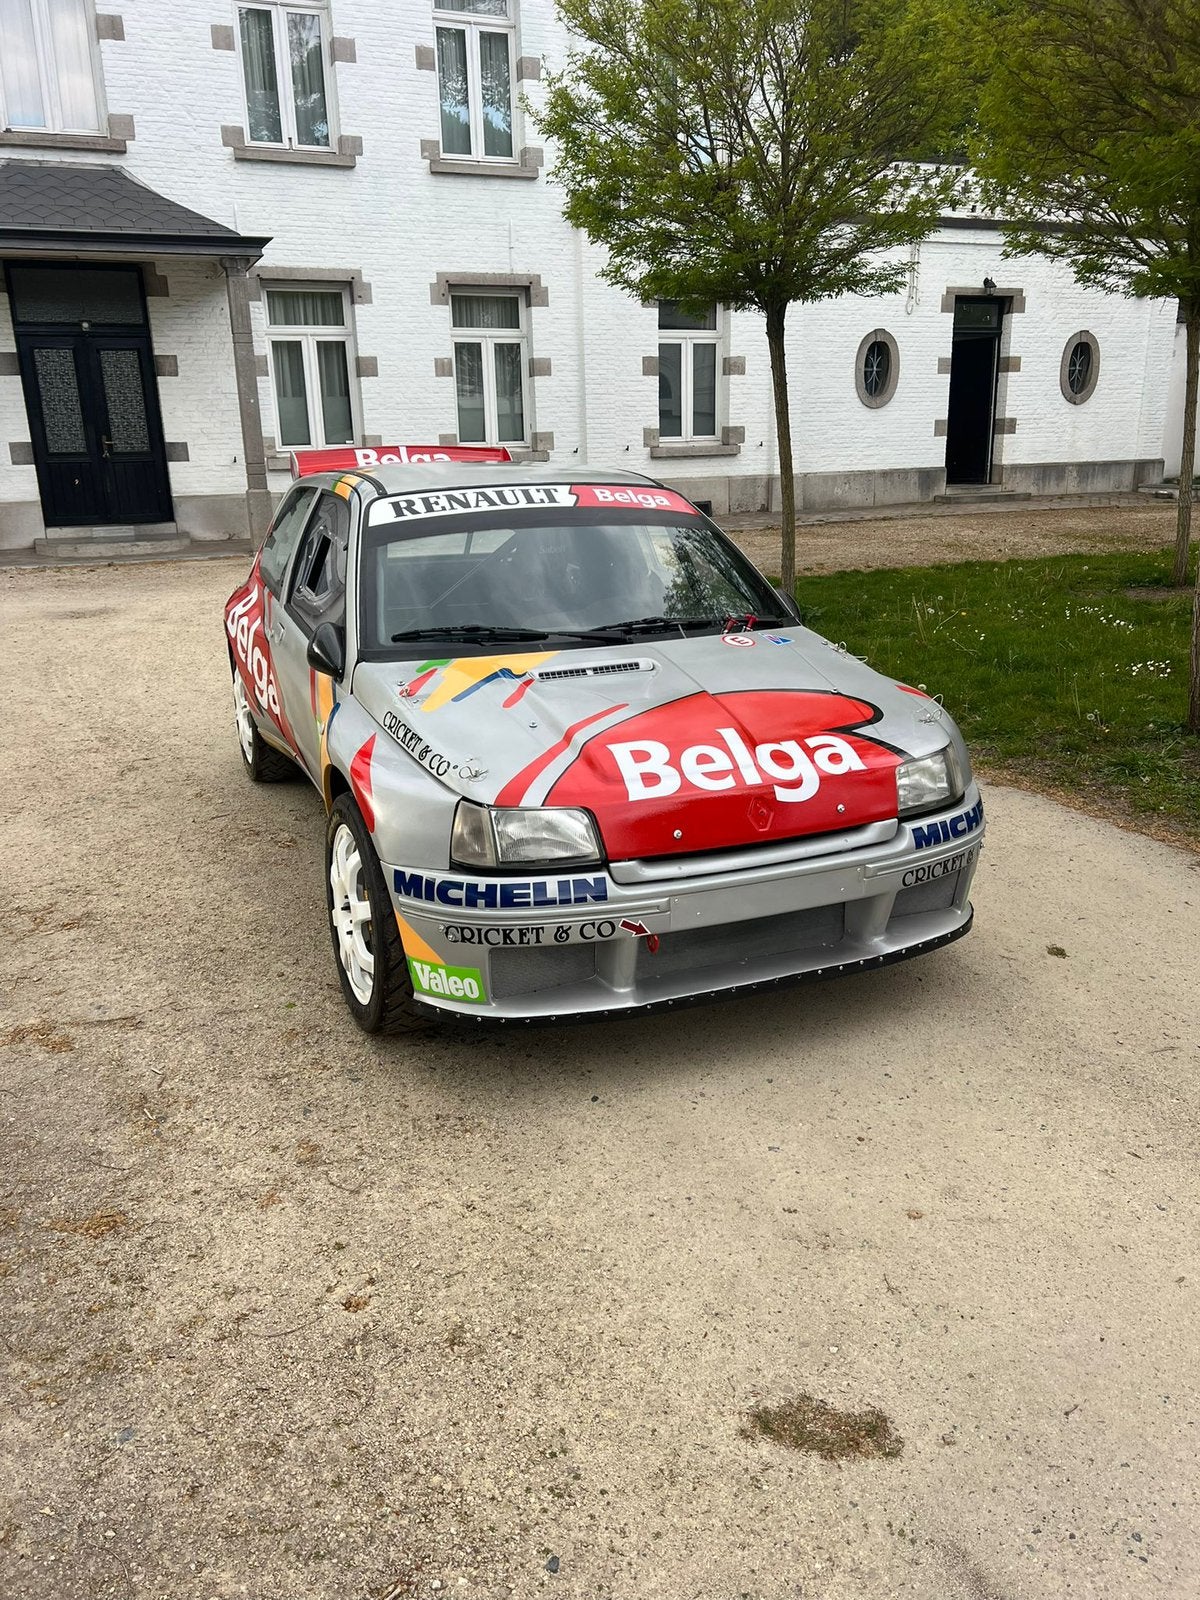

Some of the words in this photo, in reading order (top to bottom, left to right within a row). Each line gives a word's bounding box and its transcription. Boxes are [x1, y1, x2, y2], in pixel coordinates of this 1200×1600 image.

[389, 488, 560, 518] RENAULT
[592, 488, 672, 509] Belga
[227, 584, 282, 722] Belga
[383, 711, 423, 752] CRICKET
[418, 745, 432, 761] &
[606, 728, 868, 803] Belga
[393, 869, 608, 908] MICHELIN
[902, 853, 966, 887] CRICKET
[444, 923, 544, 946] CRICKET
[553, 924, 572, 944] &
[579, 920, 616, 941] CO
[412, 960, 480, 999] Valeo
